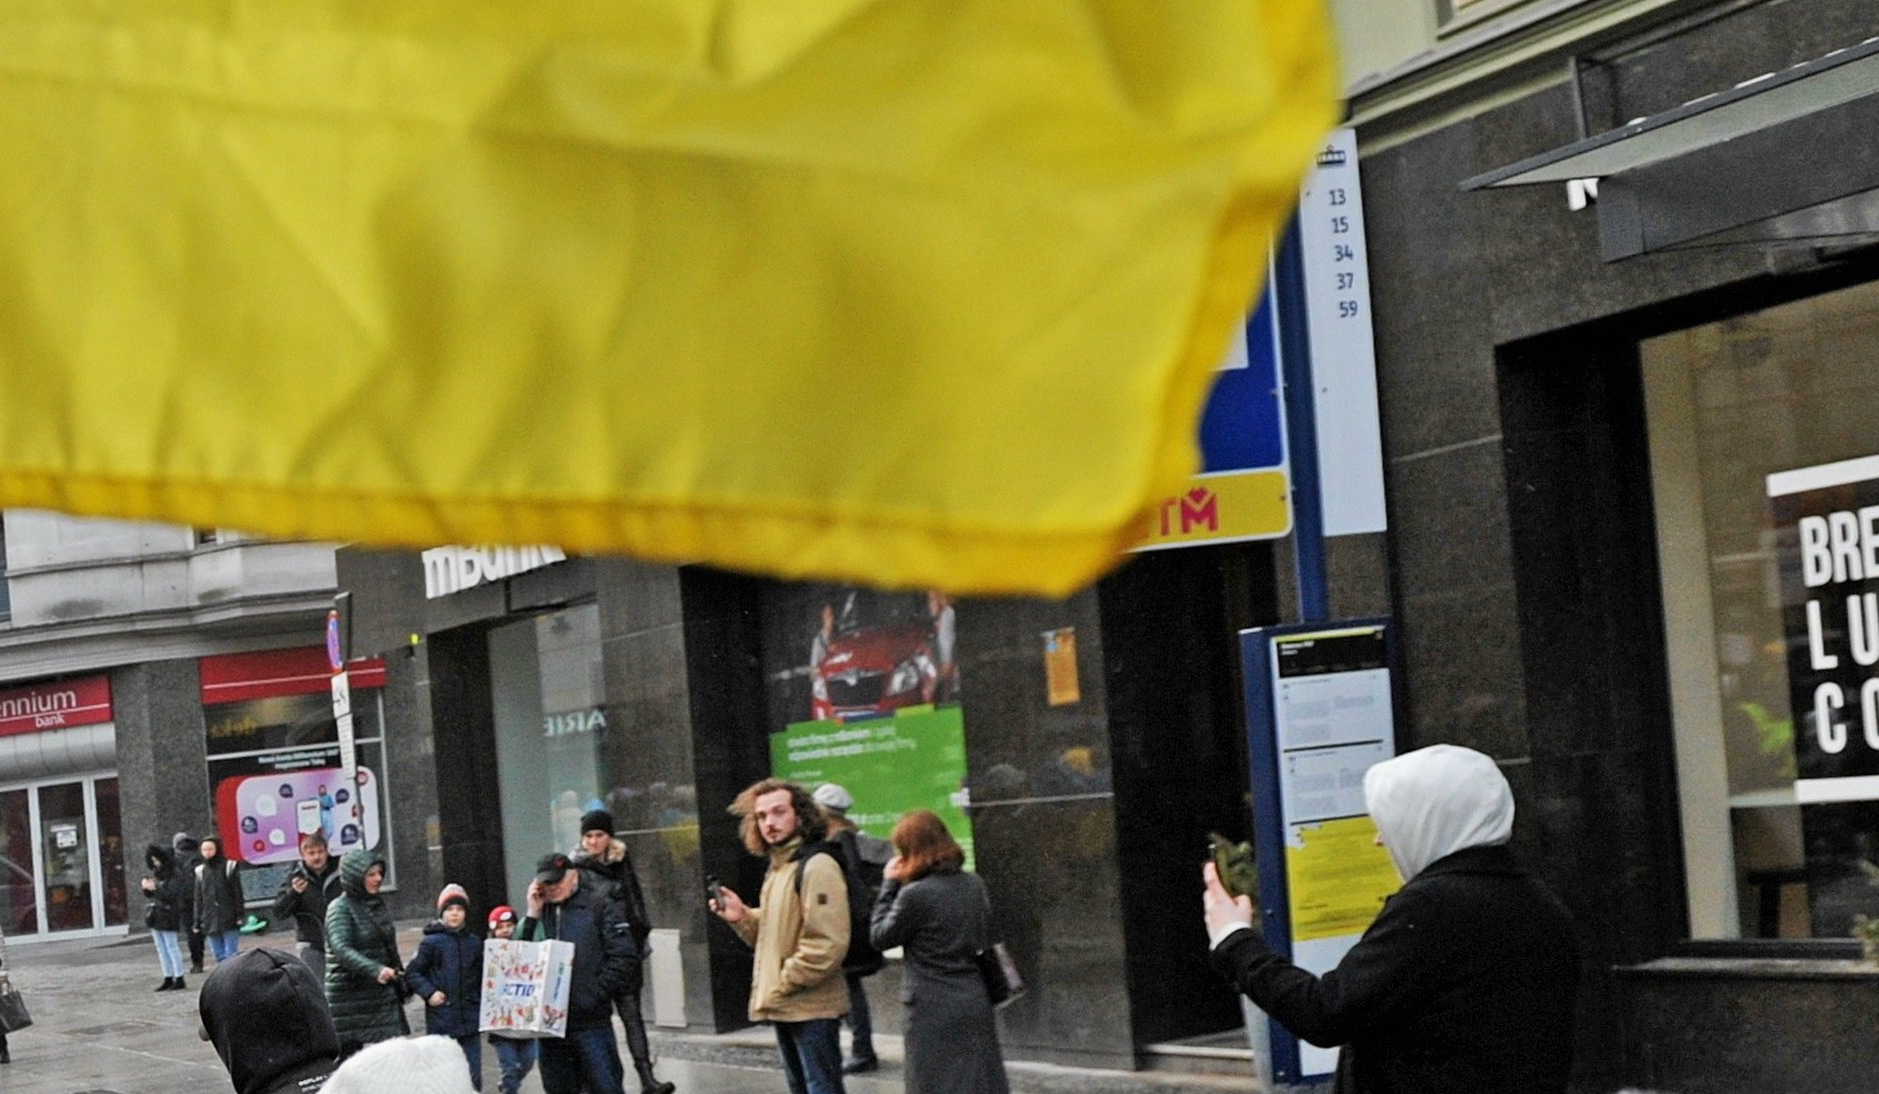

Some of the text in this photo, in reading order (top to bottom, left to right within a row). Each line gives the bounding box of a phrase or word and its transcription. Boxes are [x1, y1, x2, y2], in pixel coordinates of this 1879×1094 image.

[1329, 189, 1347, 206] 13
[1332, 217, 1350, 234] 15
[1335, 245, 1354, 262] 34
[1337, 272, 1354, 290] 37
[1339, 300, 1359, 318] 59
[34, 713, 66, 728] bank
